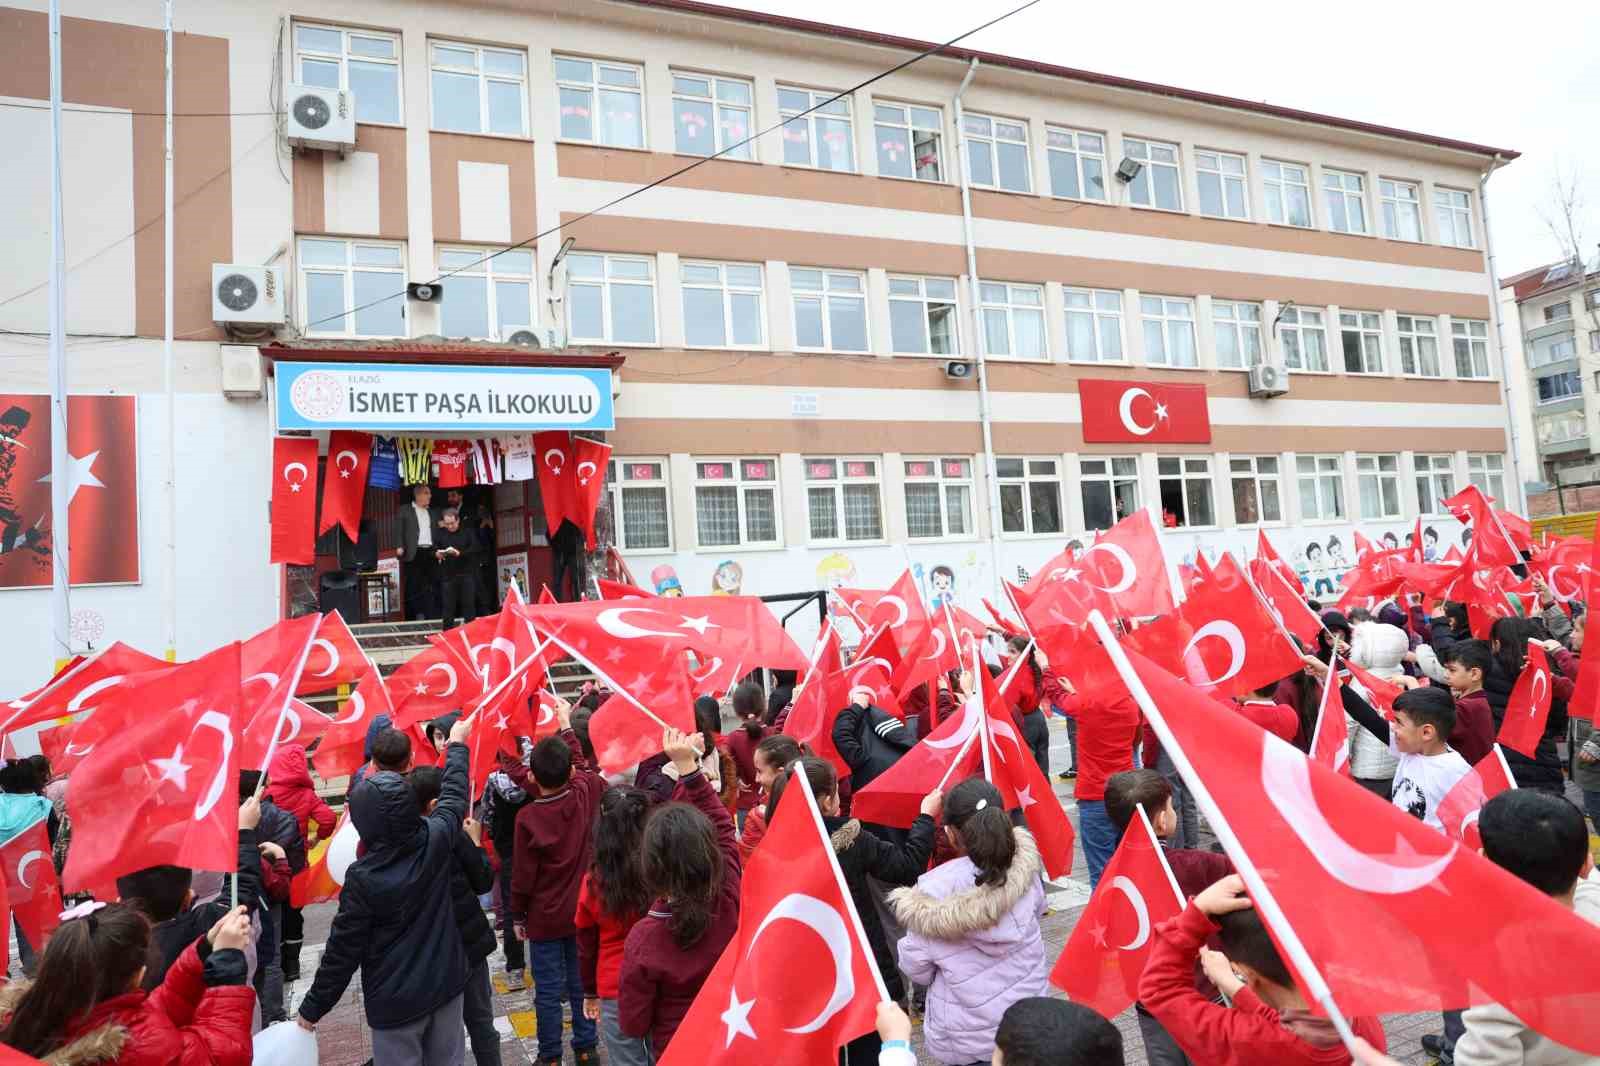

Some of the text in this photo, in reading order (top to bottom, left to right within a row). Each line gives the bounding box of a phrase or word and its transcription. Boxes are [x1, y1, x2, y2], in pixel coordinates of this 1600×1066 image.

[349, 387, 592, 419] İSMET PAŞA İLKOKULU
